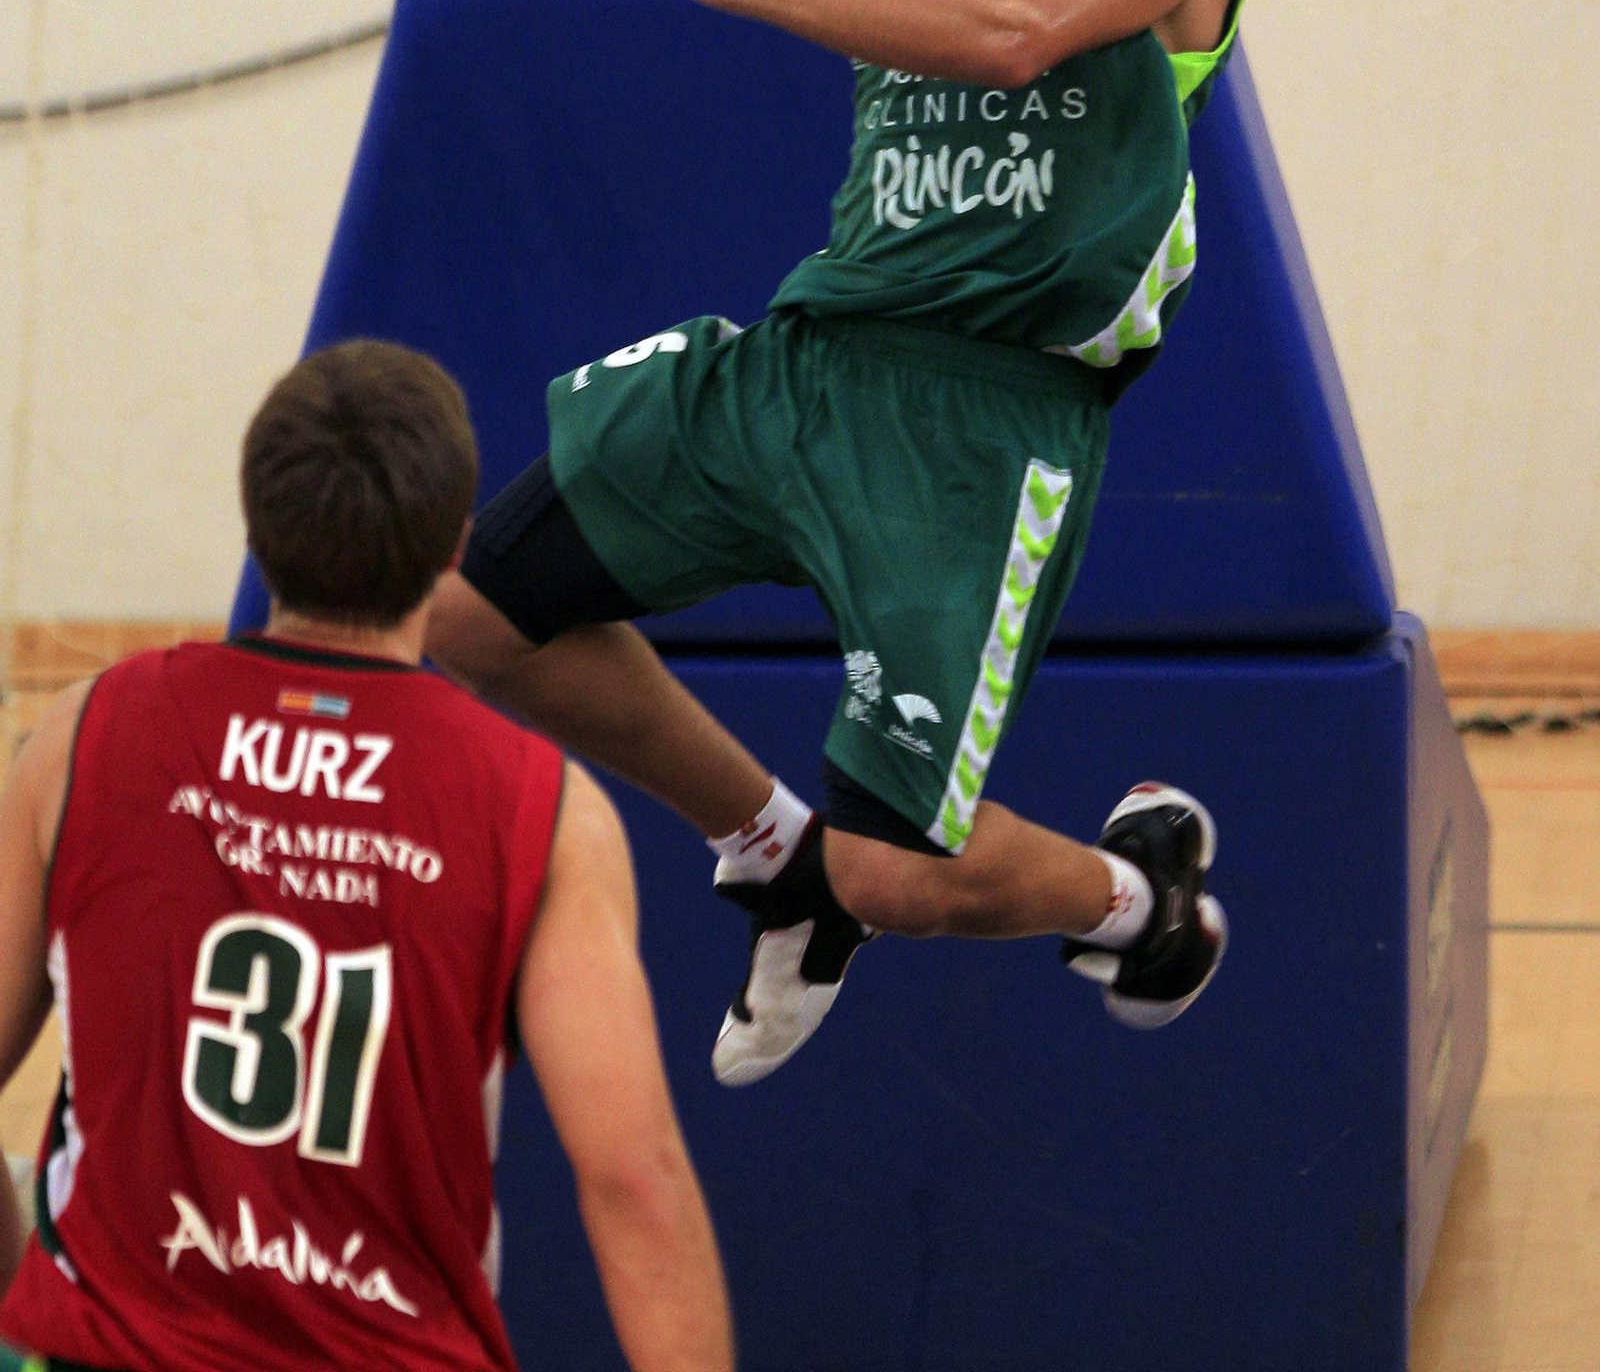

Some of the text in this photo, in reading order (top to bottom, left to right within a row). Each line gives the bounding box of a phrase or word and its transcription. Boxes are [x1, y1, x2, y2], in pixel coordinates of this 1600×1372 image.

[863, 87, 1088, 129] CLINICAS
[218, 712, 394, 804] KURZ
[181, 912, 394, 1169] 31
